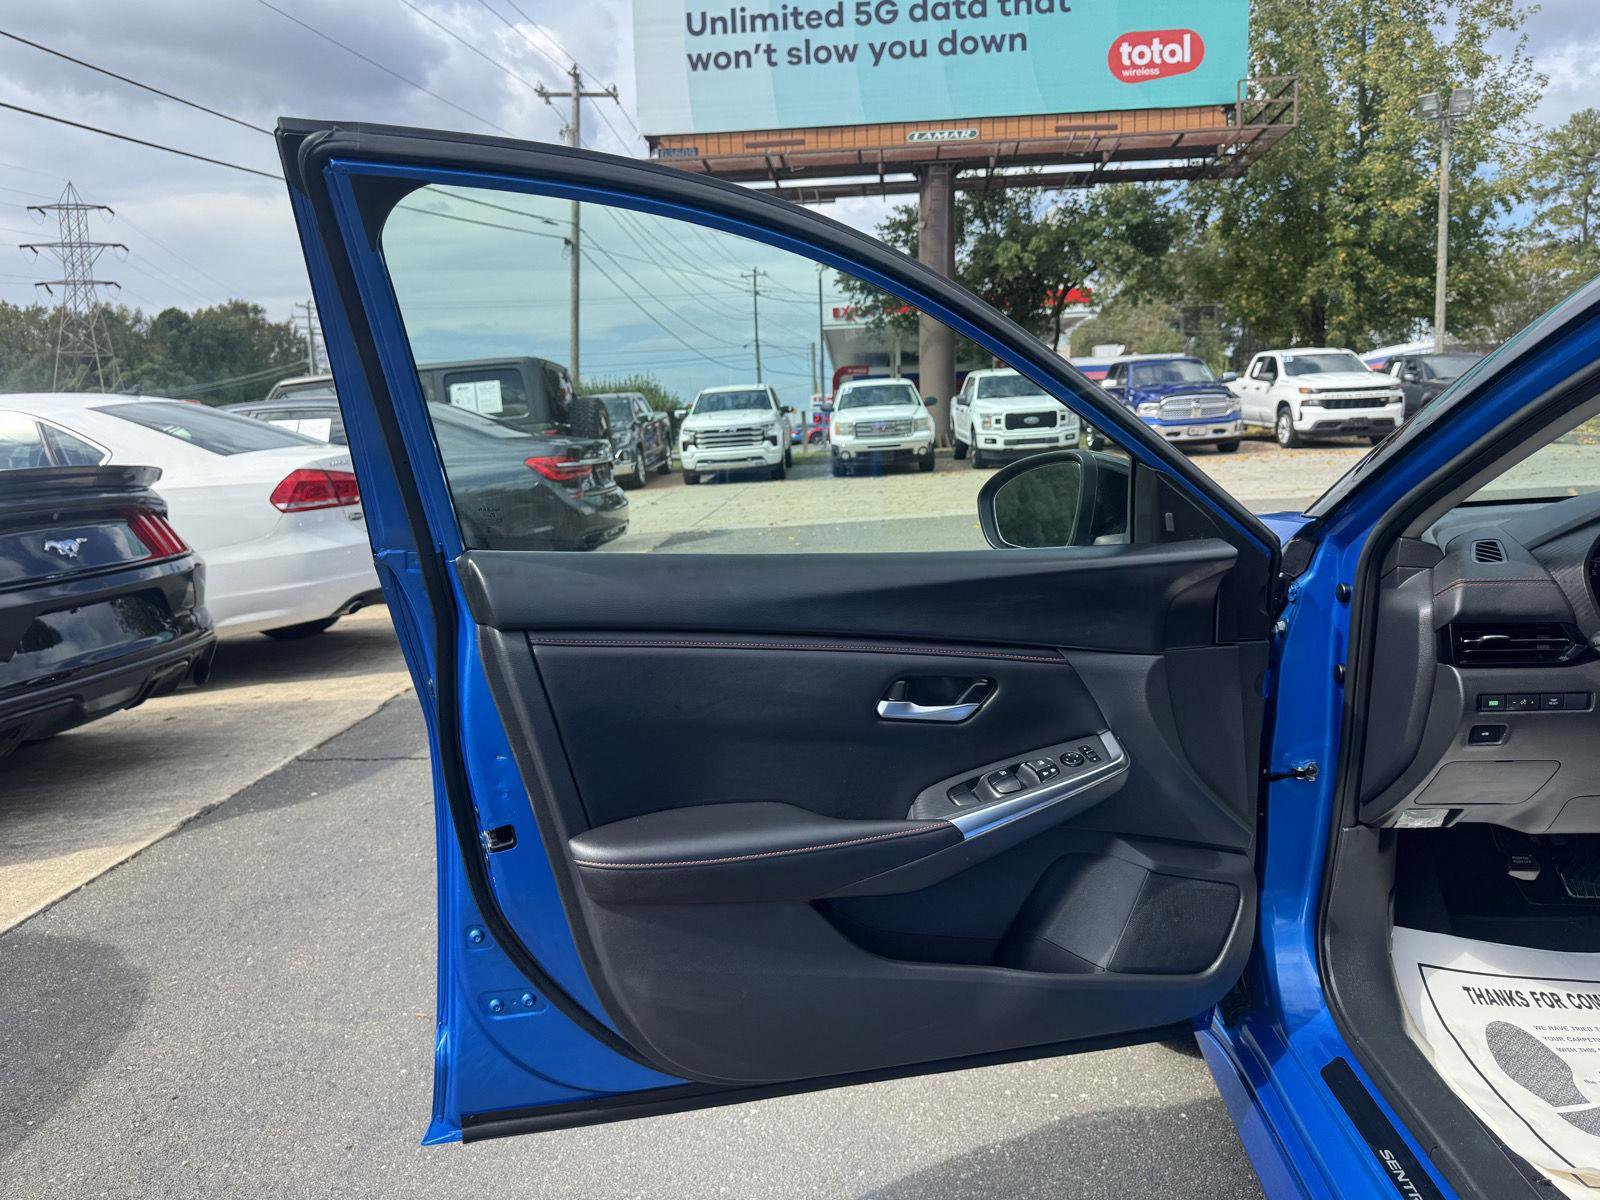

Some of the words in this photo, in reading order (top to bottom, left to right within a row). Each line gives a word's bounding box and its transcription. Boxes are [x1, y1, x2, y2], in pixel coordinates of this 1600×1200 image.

[686, 1, 845, 37] Unlimited
[854, 0, 899, 26] 5G
[908, 0, 988, 22] data
[1000, 0, 1072, 17] that
[687, 43, 778, 71] won't
[787, 39, 859, 66] slow
[868, 39, 927, 67] you
[938, 29, 1028, 56] down
[1119, 33, 1191, 66] total
[1121, 67, 1160, 77] wireless
[912, 130, 972, 140] LAMAR
[1462, 986, 1530, 1008] THANKS
[1529, 991, 1569, 1009] FOR
